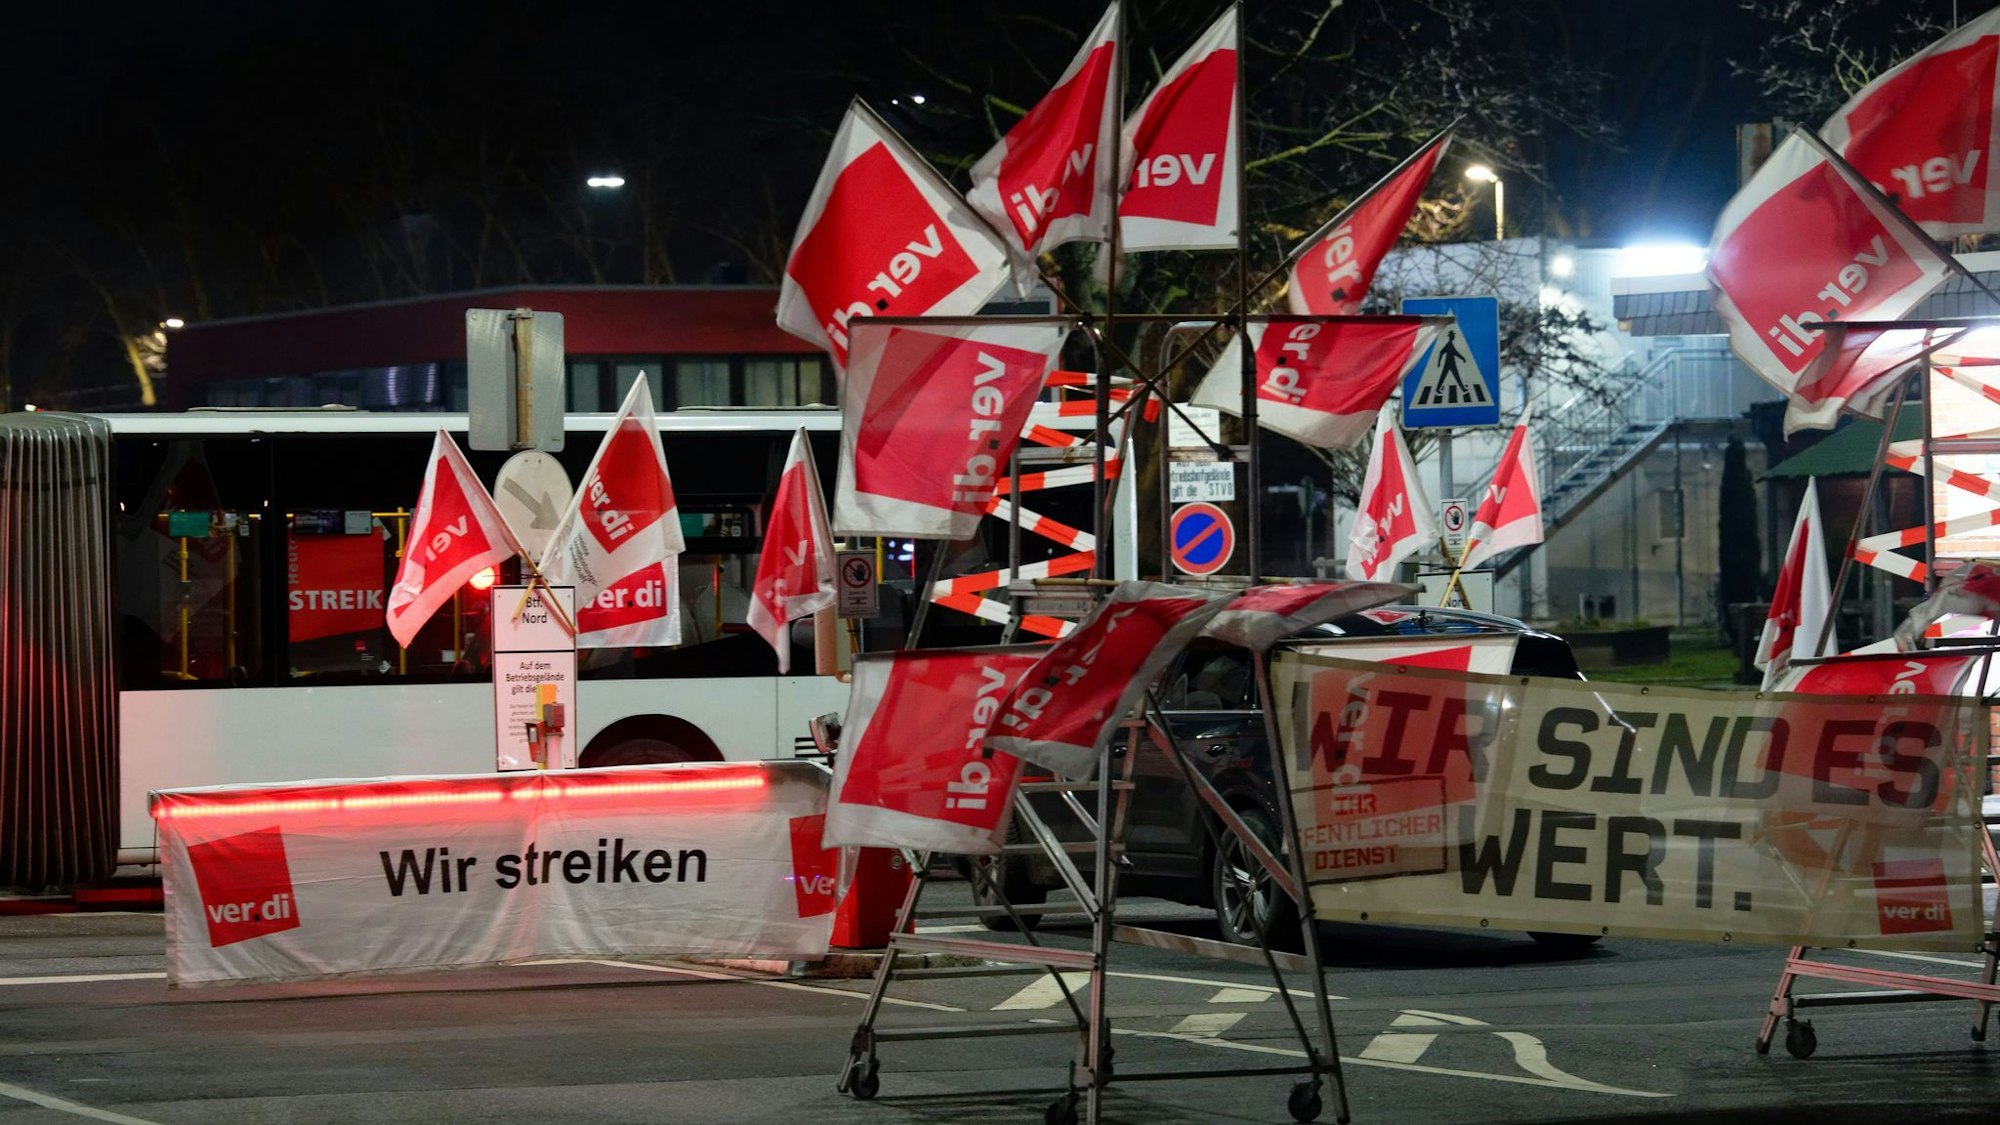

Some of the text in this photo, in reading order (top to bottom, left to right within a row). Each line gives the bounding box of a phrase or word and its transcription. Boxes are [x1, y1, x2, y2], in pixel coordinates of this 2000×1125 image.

[288, 589, 384, 611] STREIK
[522, 612, 548, 624] Nord
[520, 661, 551, 670] Auf dem
[506, 673, 565, 685] Betriebsgelände
[511, 684, 524, 695] gilt
[1291, 680, 1943, 810] WIR SIND ES
[1335, 794, 1377, 816] IHR
[379, 838, 708, 897] Wir streiken
[1315, 844, 1399, 871] DIENST
[1458, 804, 1752, 912] WERT.
[799, 875, 836, 896] ve
[208, 892, 291, 924] ver.di
